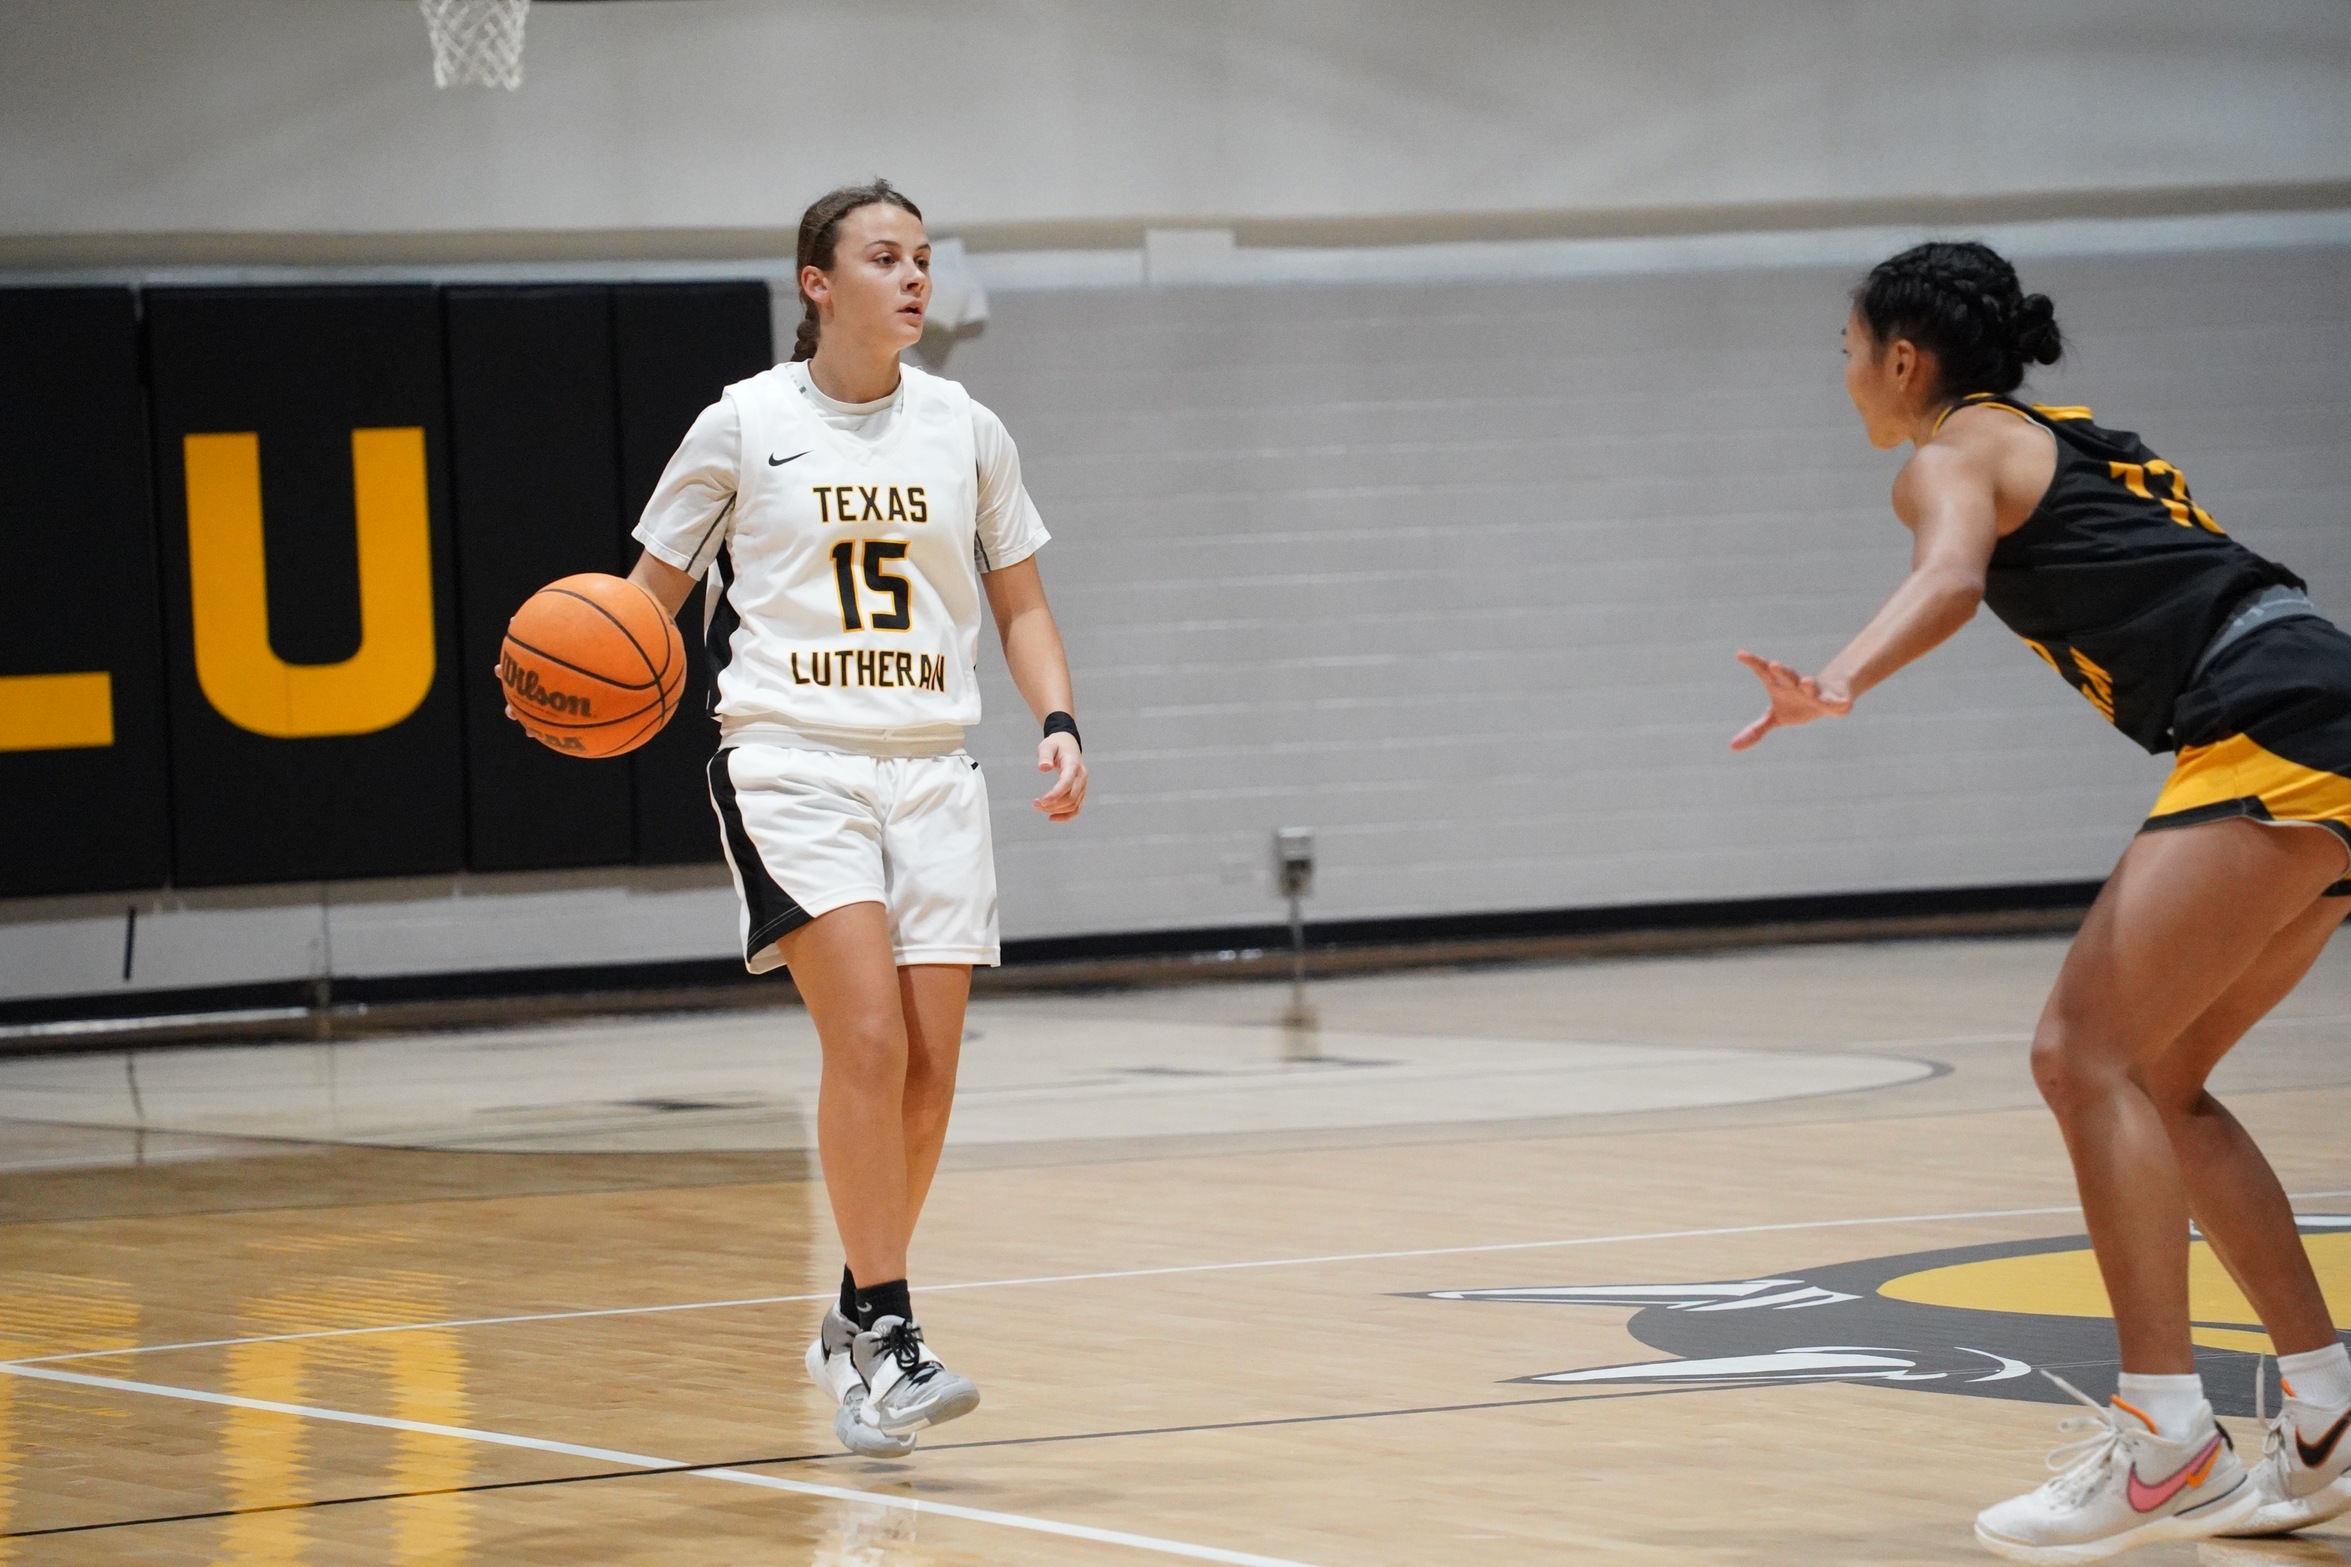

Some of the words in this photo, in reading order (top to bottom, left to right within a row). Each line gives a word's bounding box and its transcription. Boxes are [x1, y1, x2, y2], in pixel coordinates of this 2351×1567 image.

[812, 485, 928, 524] TEXAS
[828, 538, 912, 634] 15
[790, 649, 946, 693] LUTHERAN
